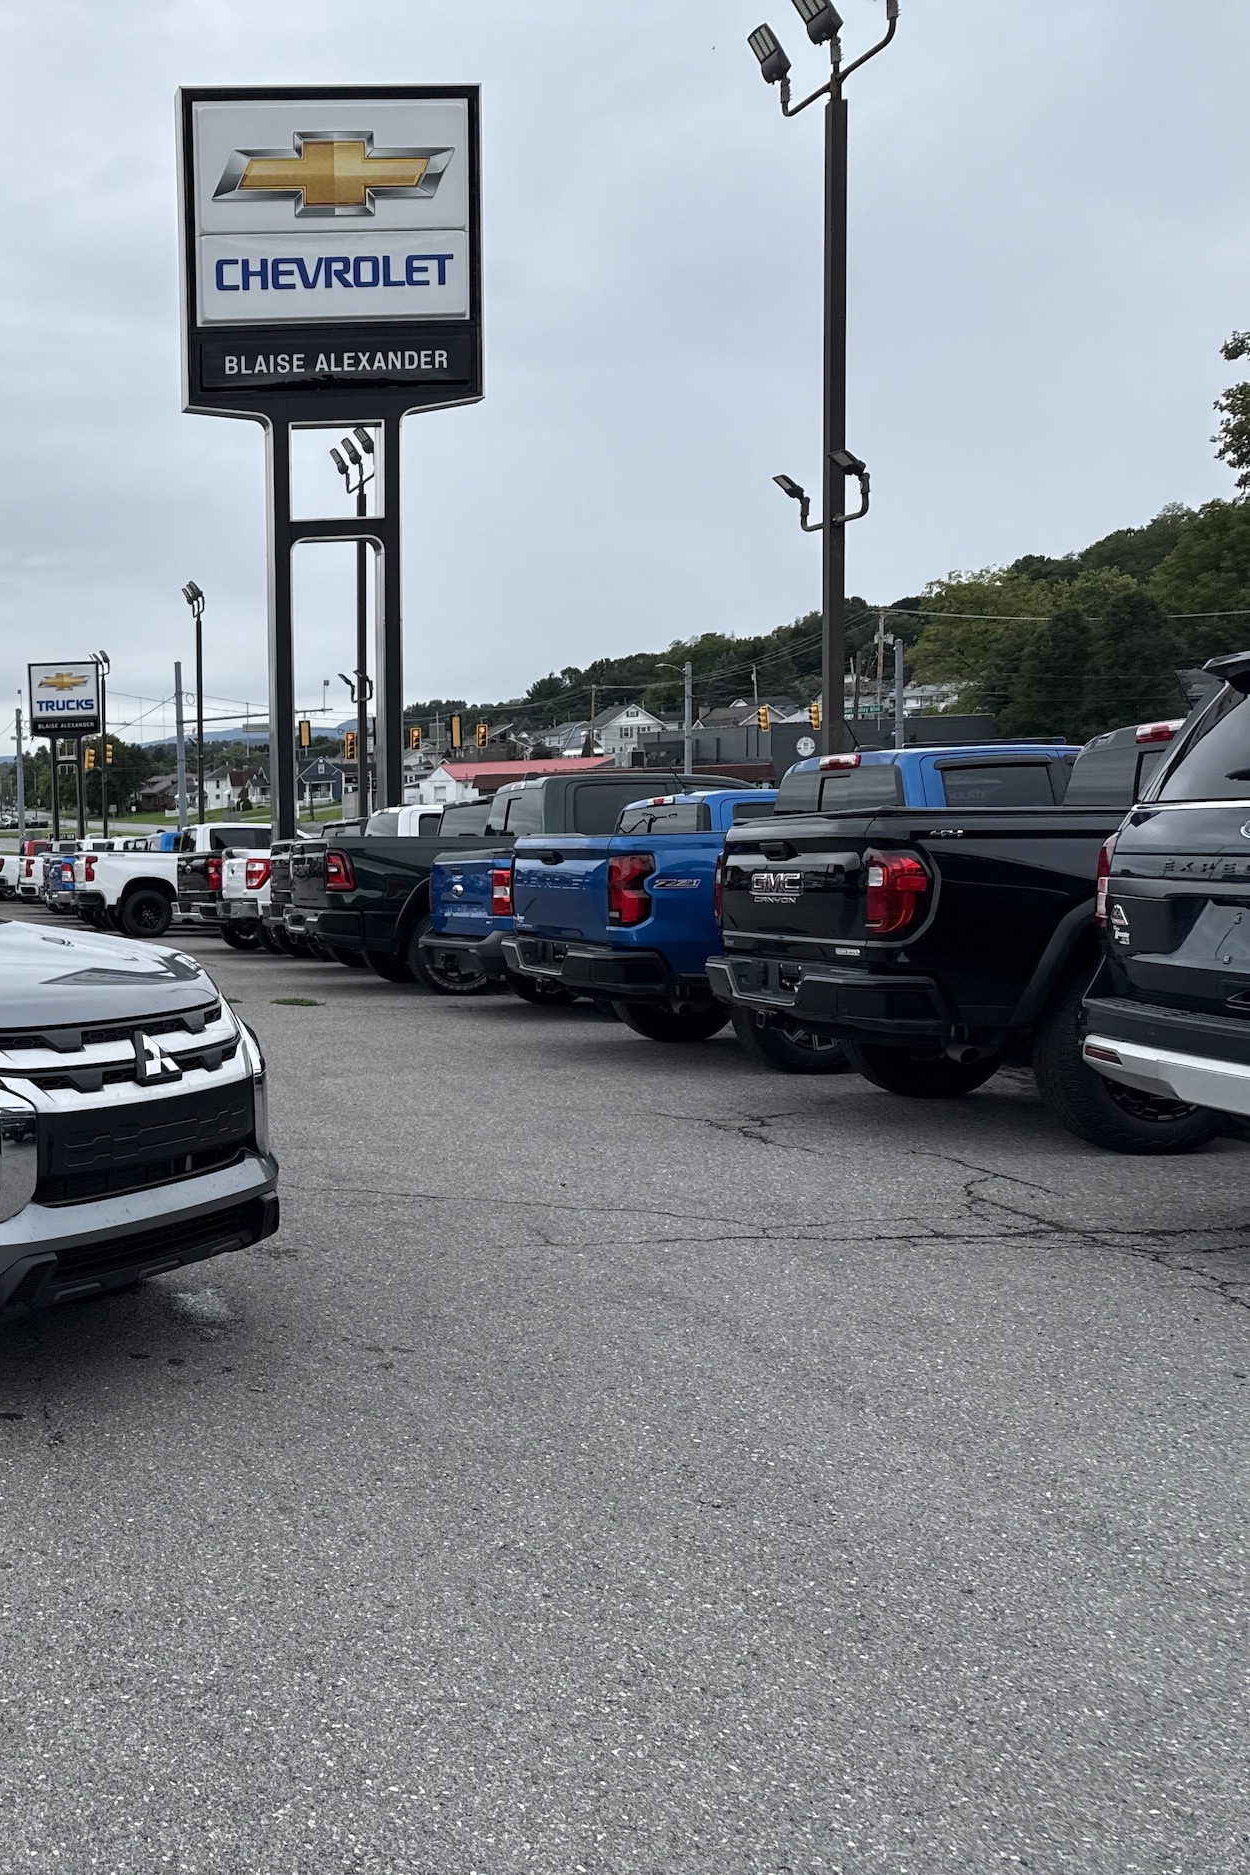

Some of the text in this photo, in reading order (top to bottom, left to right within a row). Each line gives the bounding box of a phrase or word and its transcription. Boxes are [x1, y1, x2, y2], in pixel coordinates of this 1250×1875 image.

[215, 254, 454, 291] CHEVROLET
[224, 350, 448, 375] BLAISE ALEXANDER
[36, 699, 94, 711] TRUCKS
[60, 721, 95, 729] ALEXANDER
[751, 872, 802, 893] GMC
[753, 896, 797, 904] CANYON
